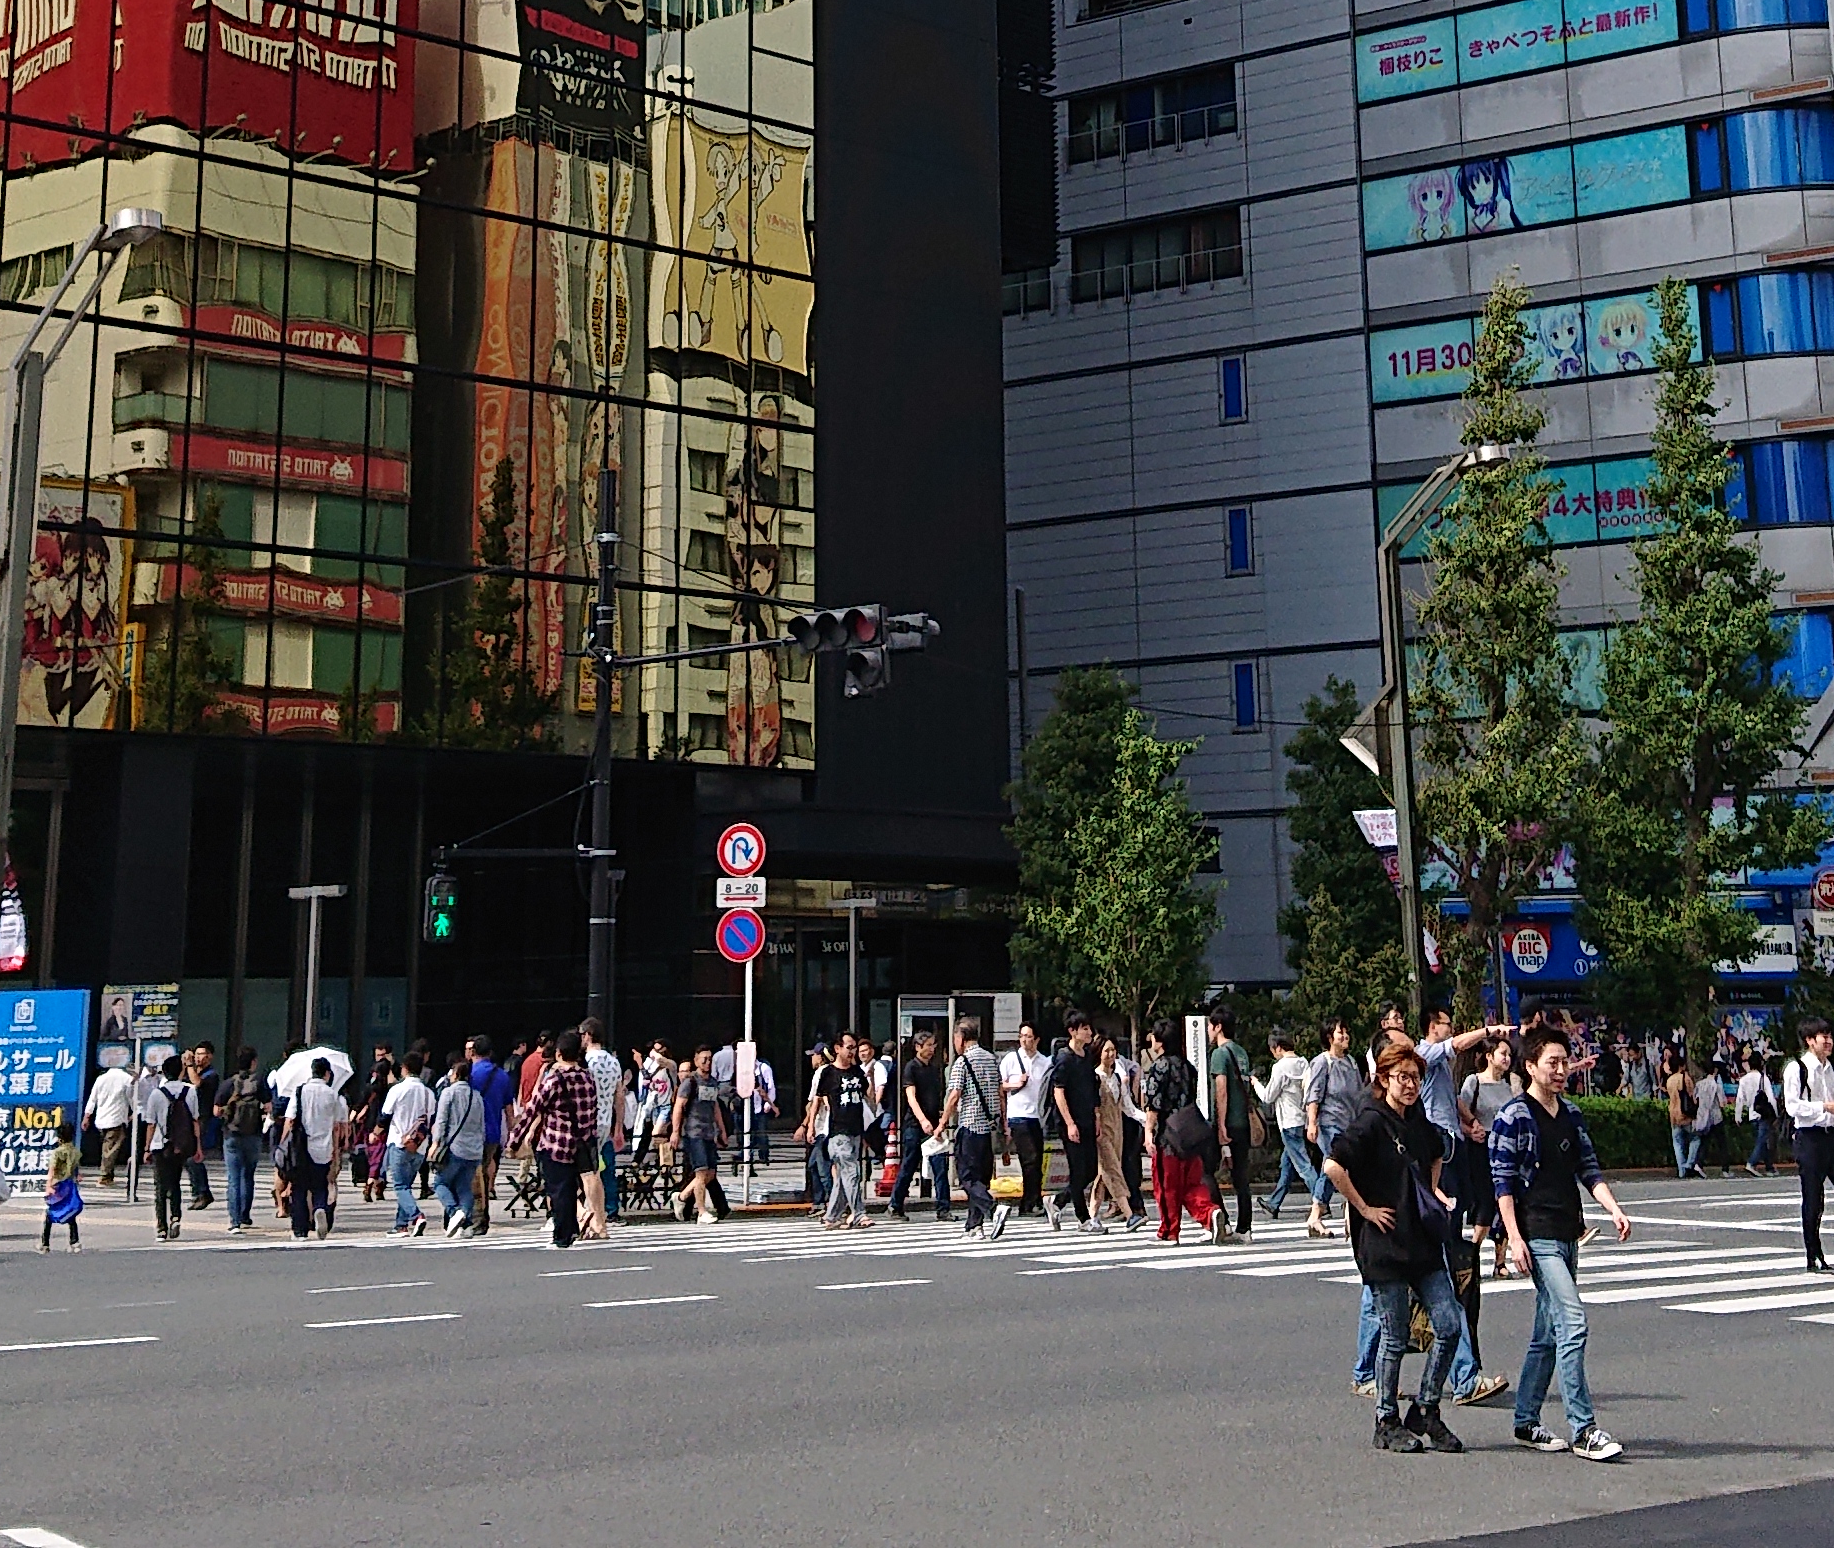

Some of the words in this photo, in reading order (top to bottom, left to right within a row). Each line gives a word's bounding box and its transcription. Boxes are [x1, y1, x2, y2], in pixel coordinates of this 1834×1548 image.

[1517, 931, 1542, 941] AKIBA
[1518, 943, 1542, 955] BIC
[1517, 955, 1546, 973] map
[15, 1108, 63, 1129] No.1
